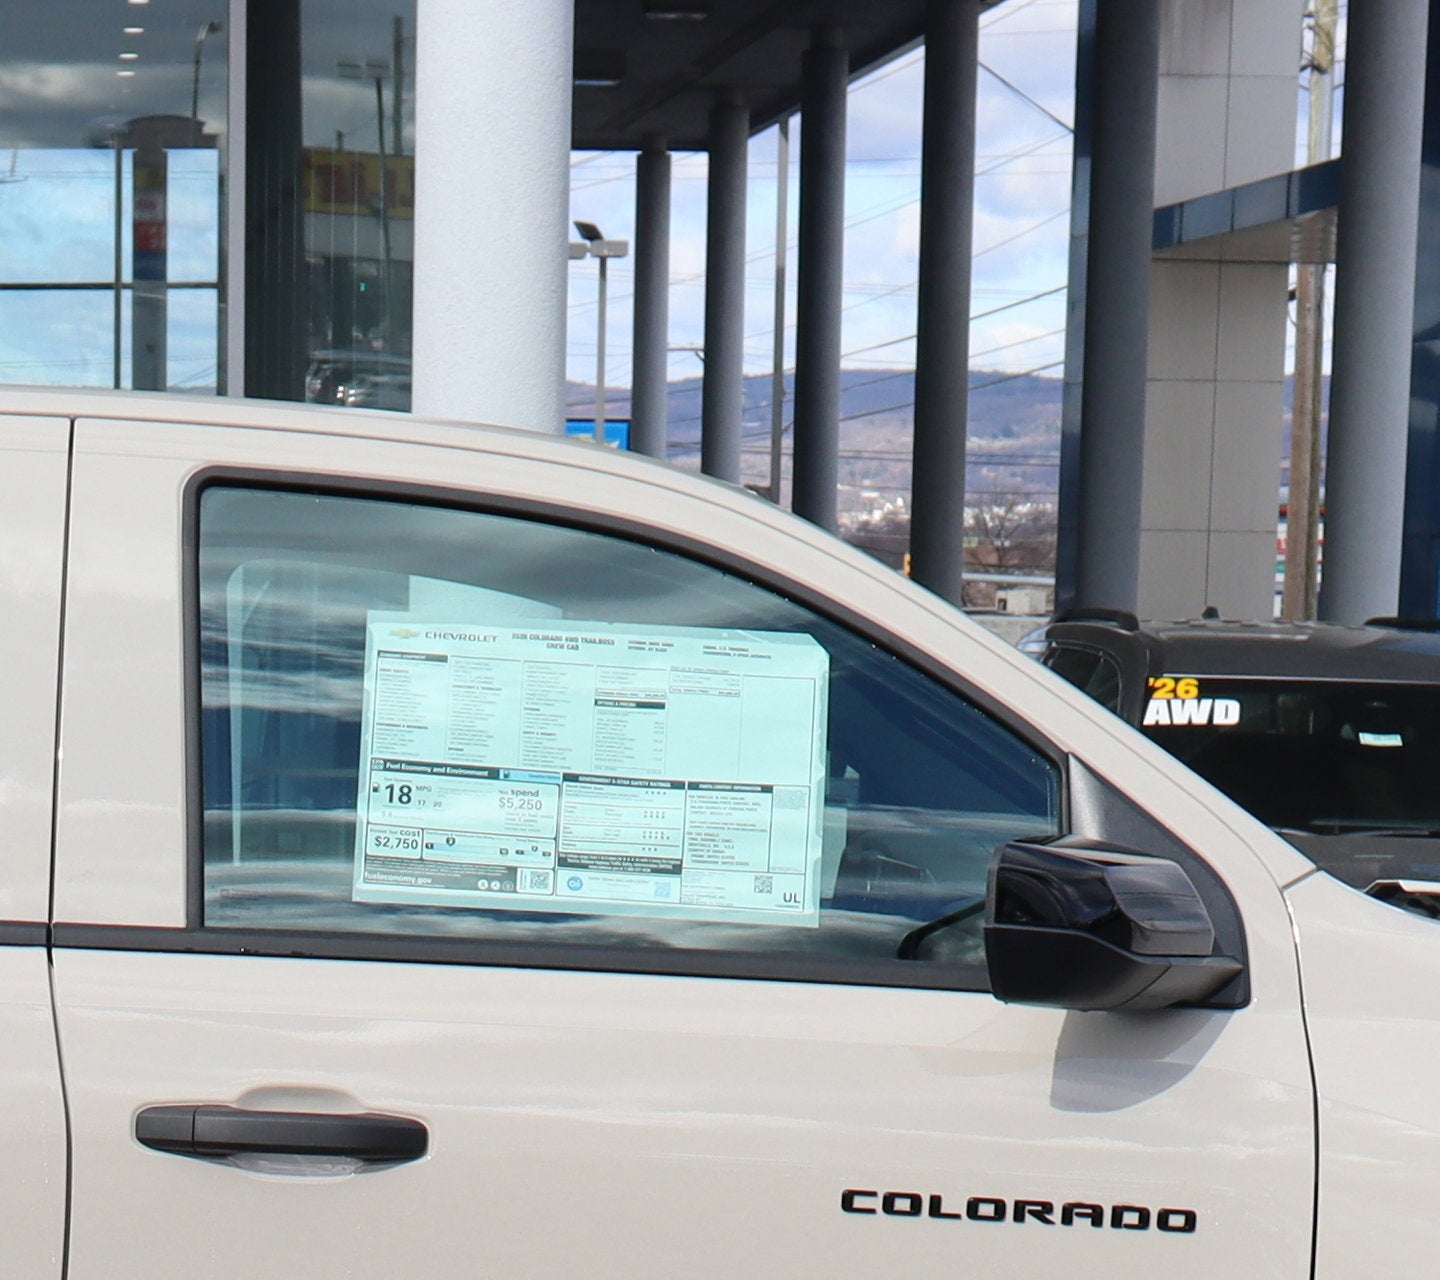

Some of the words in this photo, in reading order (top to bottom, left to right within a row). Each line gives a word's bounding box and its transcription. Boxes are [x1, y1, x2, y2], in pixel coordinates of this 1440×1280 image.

[425, 631, 497, 643] CHEVROLET
[1148, 677, 1199, 699] '26
[1142, 698, 1241, 726] AWD
[385, 783, 412, 805] 18
[511, 789, 540, 798] spend
[498, 796, 543, 811] $5,250
[400, 829, 420, 837] cost
[374, 834, 418, 850] $2,750
[840, 1189, 1197, 1233] COLORADO
